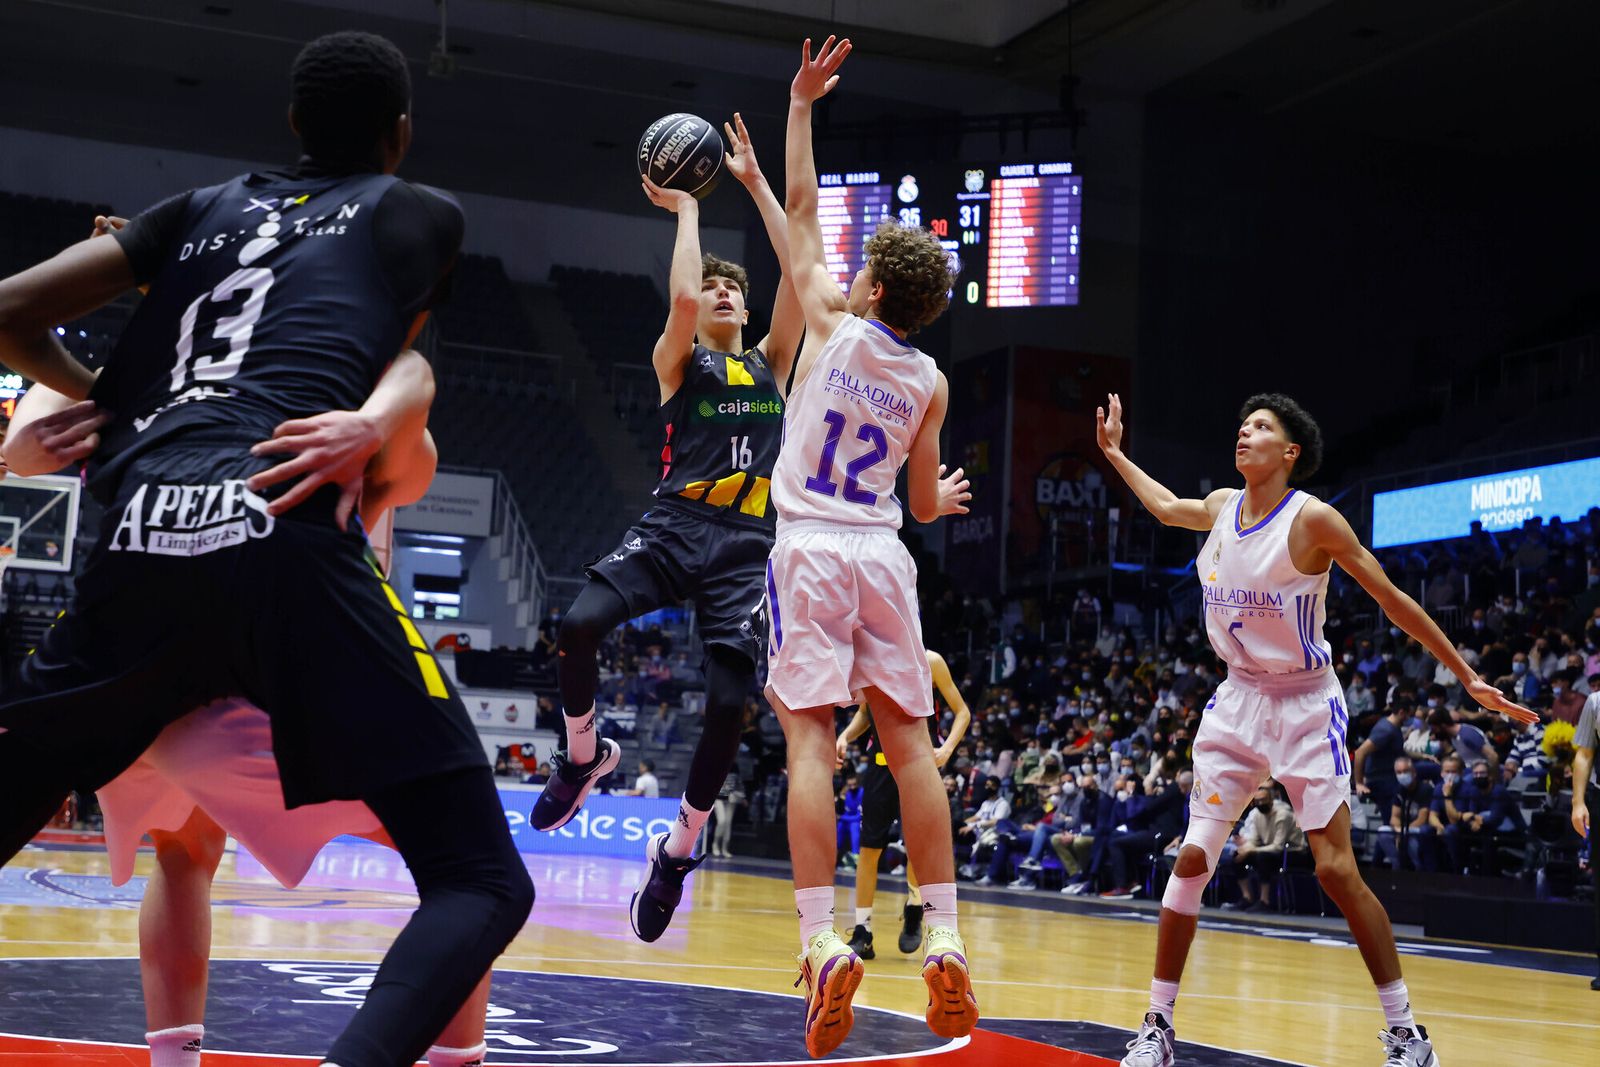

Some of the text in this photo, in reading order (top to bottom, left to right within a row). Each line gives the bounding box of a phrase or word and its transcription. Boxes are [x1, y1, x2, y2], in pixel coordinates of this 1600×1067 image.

[653, 120, 699, 171] MINICOPA
[669, 133, 698, 163] ENDESA
[820, 172, 880, 185] REAL MADRID
[898, 207, 921, 227] 35
[958, 204, 981, 228] 31
[966, 281, 979, 304] 0
[169, 267, 275, 392] 13
[717, 398, 782, 416] cajasiete
[823, 386, 908, 427] HOTEL GROUP
[828, 368, 914, 417] PALLADIUM
[730, 435, 753, 470] 16
[805, 409, 889, 507] 12
[1471, 474, 1543, 512] MINICOPA
[108, 478, 276, 553] APELES
[1480, 507, 1534, 528] endesa
[1202, 584, 1283, 607] PALLADIUM
[1239, 610, 1284, 620] GROUP
